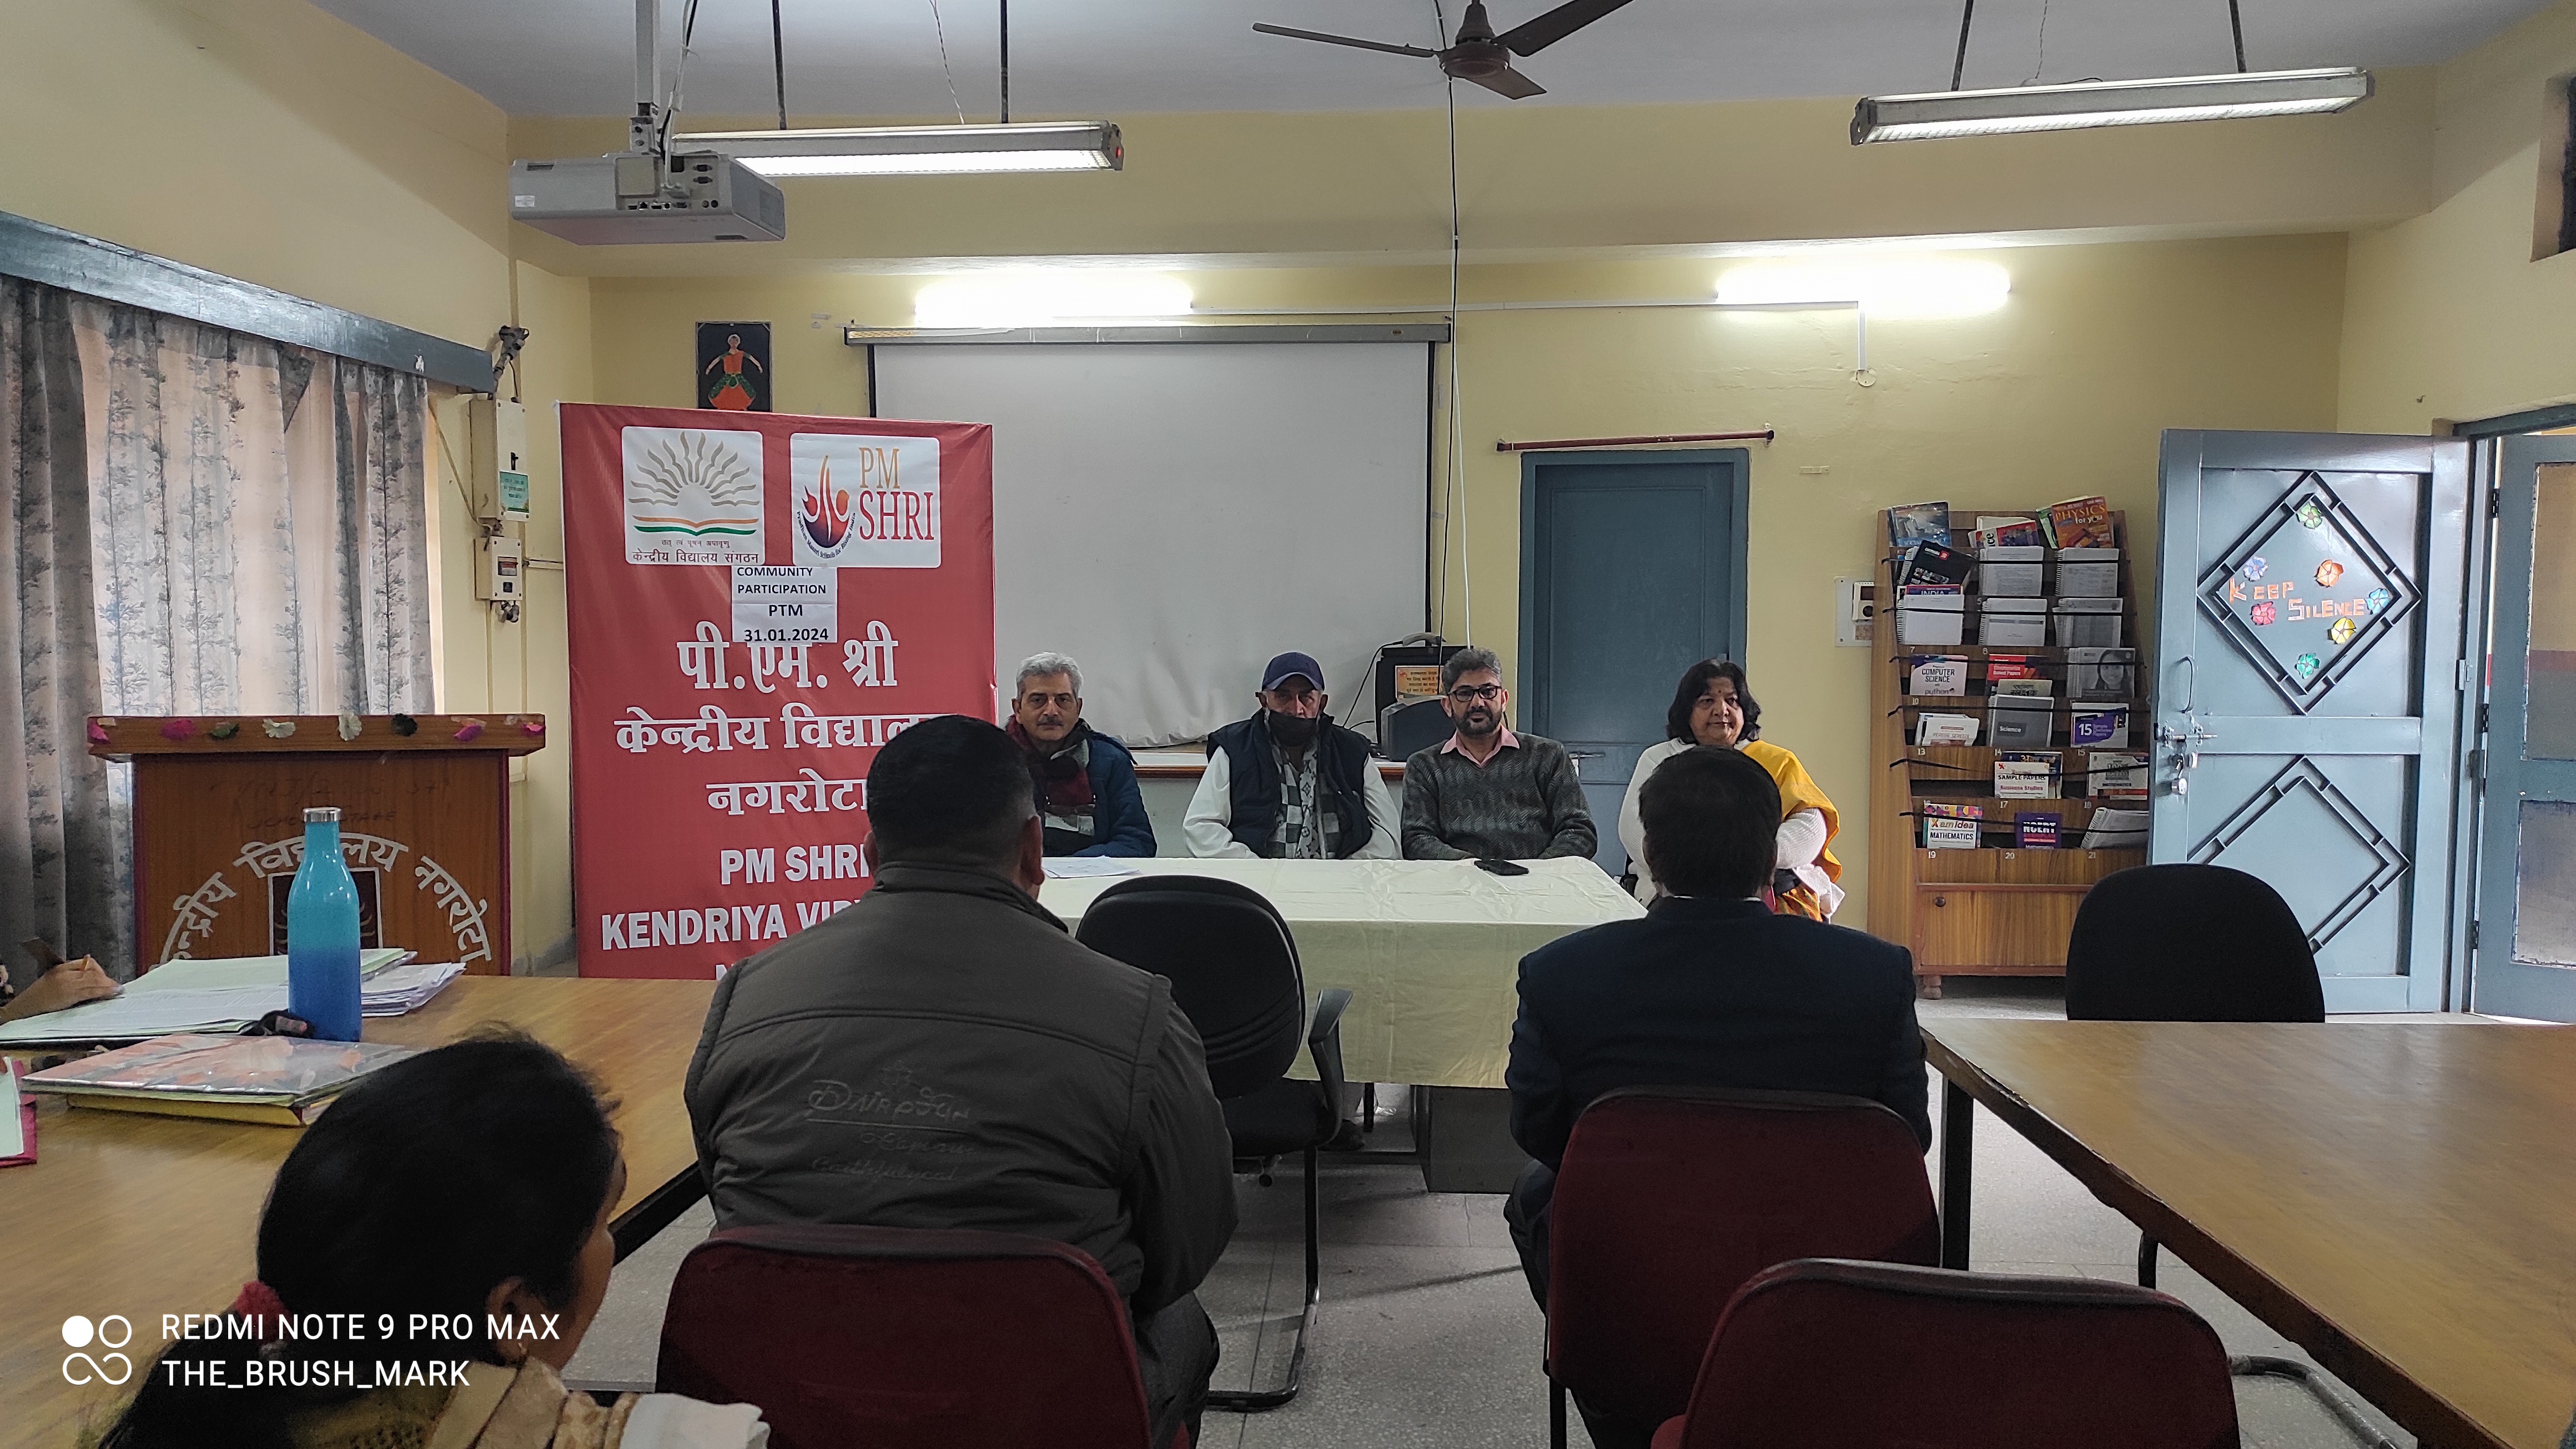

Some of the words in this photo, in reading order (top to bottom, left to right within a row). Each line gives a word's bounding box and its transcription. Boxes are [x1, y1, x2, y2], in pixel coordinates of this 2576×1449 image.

[860, 446, 900, 489] PM
[859, 490, 934, 541] SHRI
[2055, 504, 2105, 521] PHYSICS
[632, 548, 669, 562] केन्द्रीय
[676, 549, 718, 563] विद्यालय
[724, 550, 759, 563] संगठन
[737, 567, 813, 576] COMMUNITY
[738, 584, 826, 594] PARTICIPATION
[769, 604, 803, 617] PTM
[2288, 598, 2366, 621] SILENCE
[744, 628, 829, 642] 31.01.2024
[842, 620, 899, 687] श्री
[614, 705, 770, 753] केन्द्रीय
[2079, 723, 2092, 736] 15
[1930, 832, 1974, 840] MATHEMATICS
[721, 847, 774, 885] PM
[784, 844, 869, 882] SHRI
[602, 903, 788, 950] KENDRIYA
